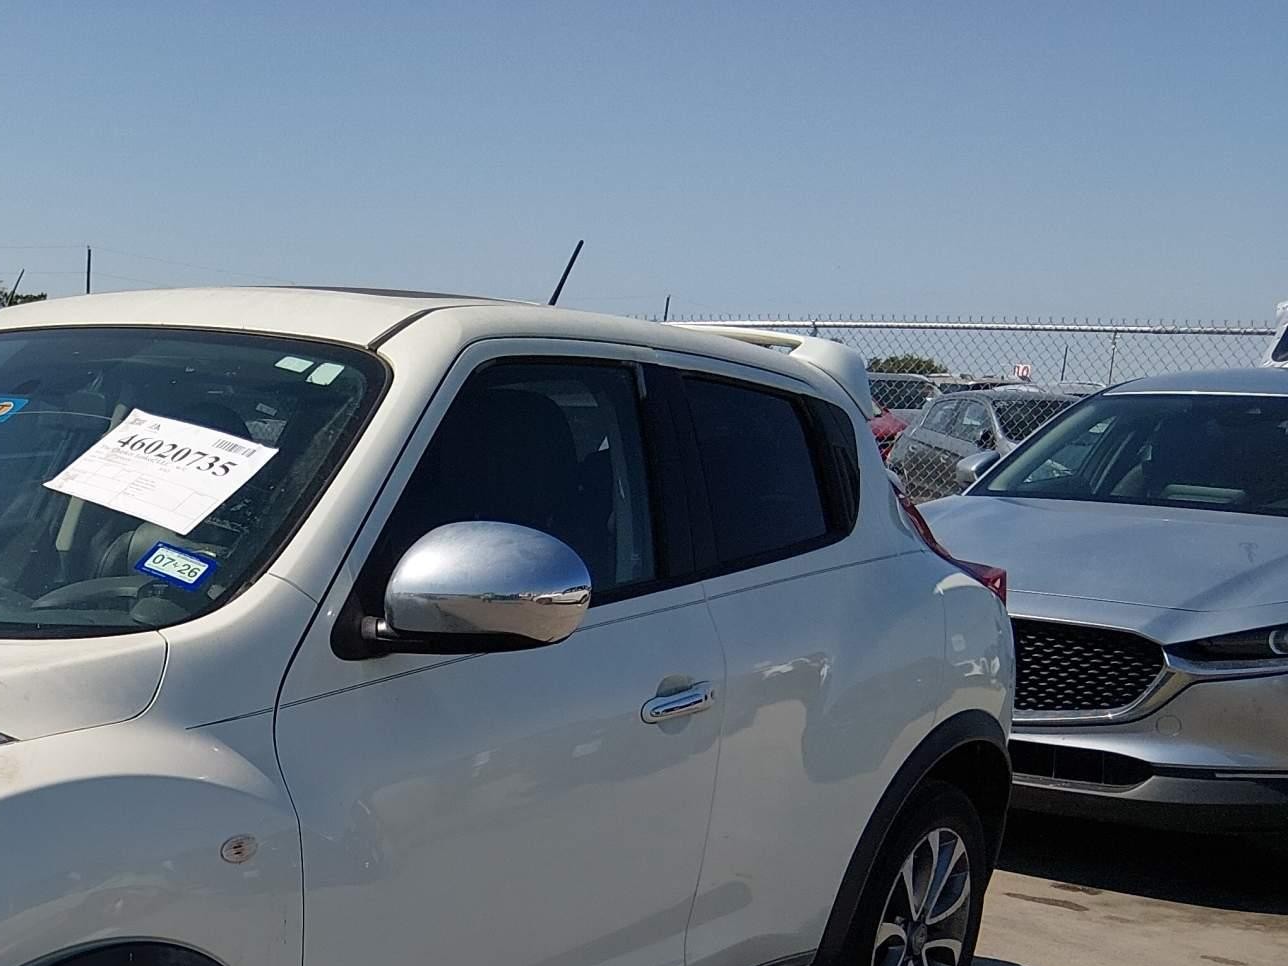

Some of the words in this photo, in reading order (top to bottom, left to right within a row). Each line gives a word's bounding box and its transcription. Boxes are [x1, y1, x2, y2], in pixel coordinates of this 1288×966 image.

[117, 433, 239, 478] 46020735
[152, 553, 176, 568] 07
[176, 563, 201, 578] 26
